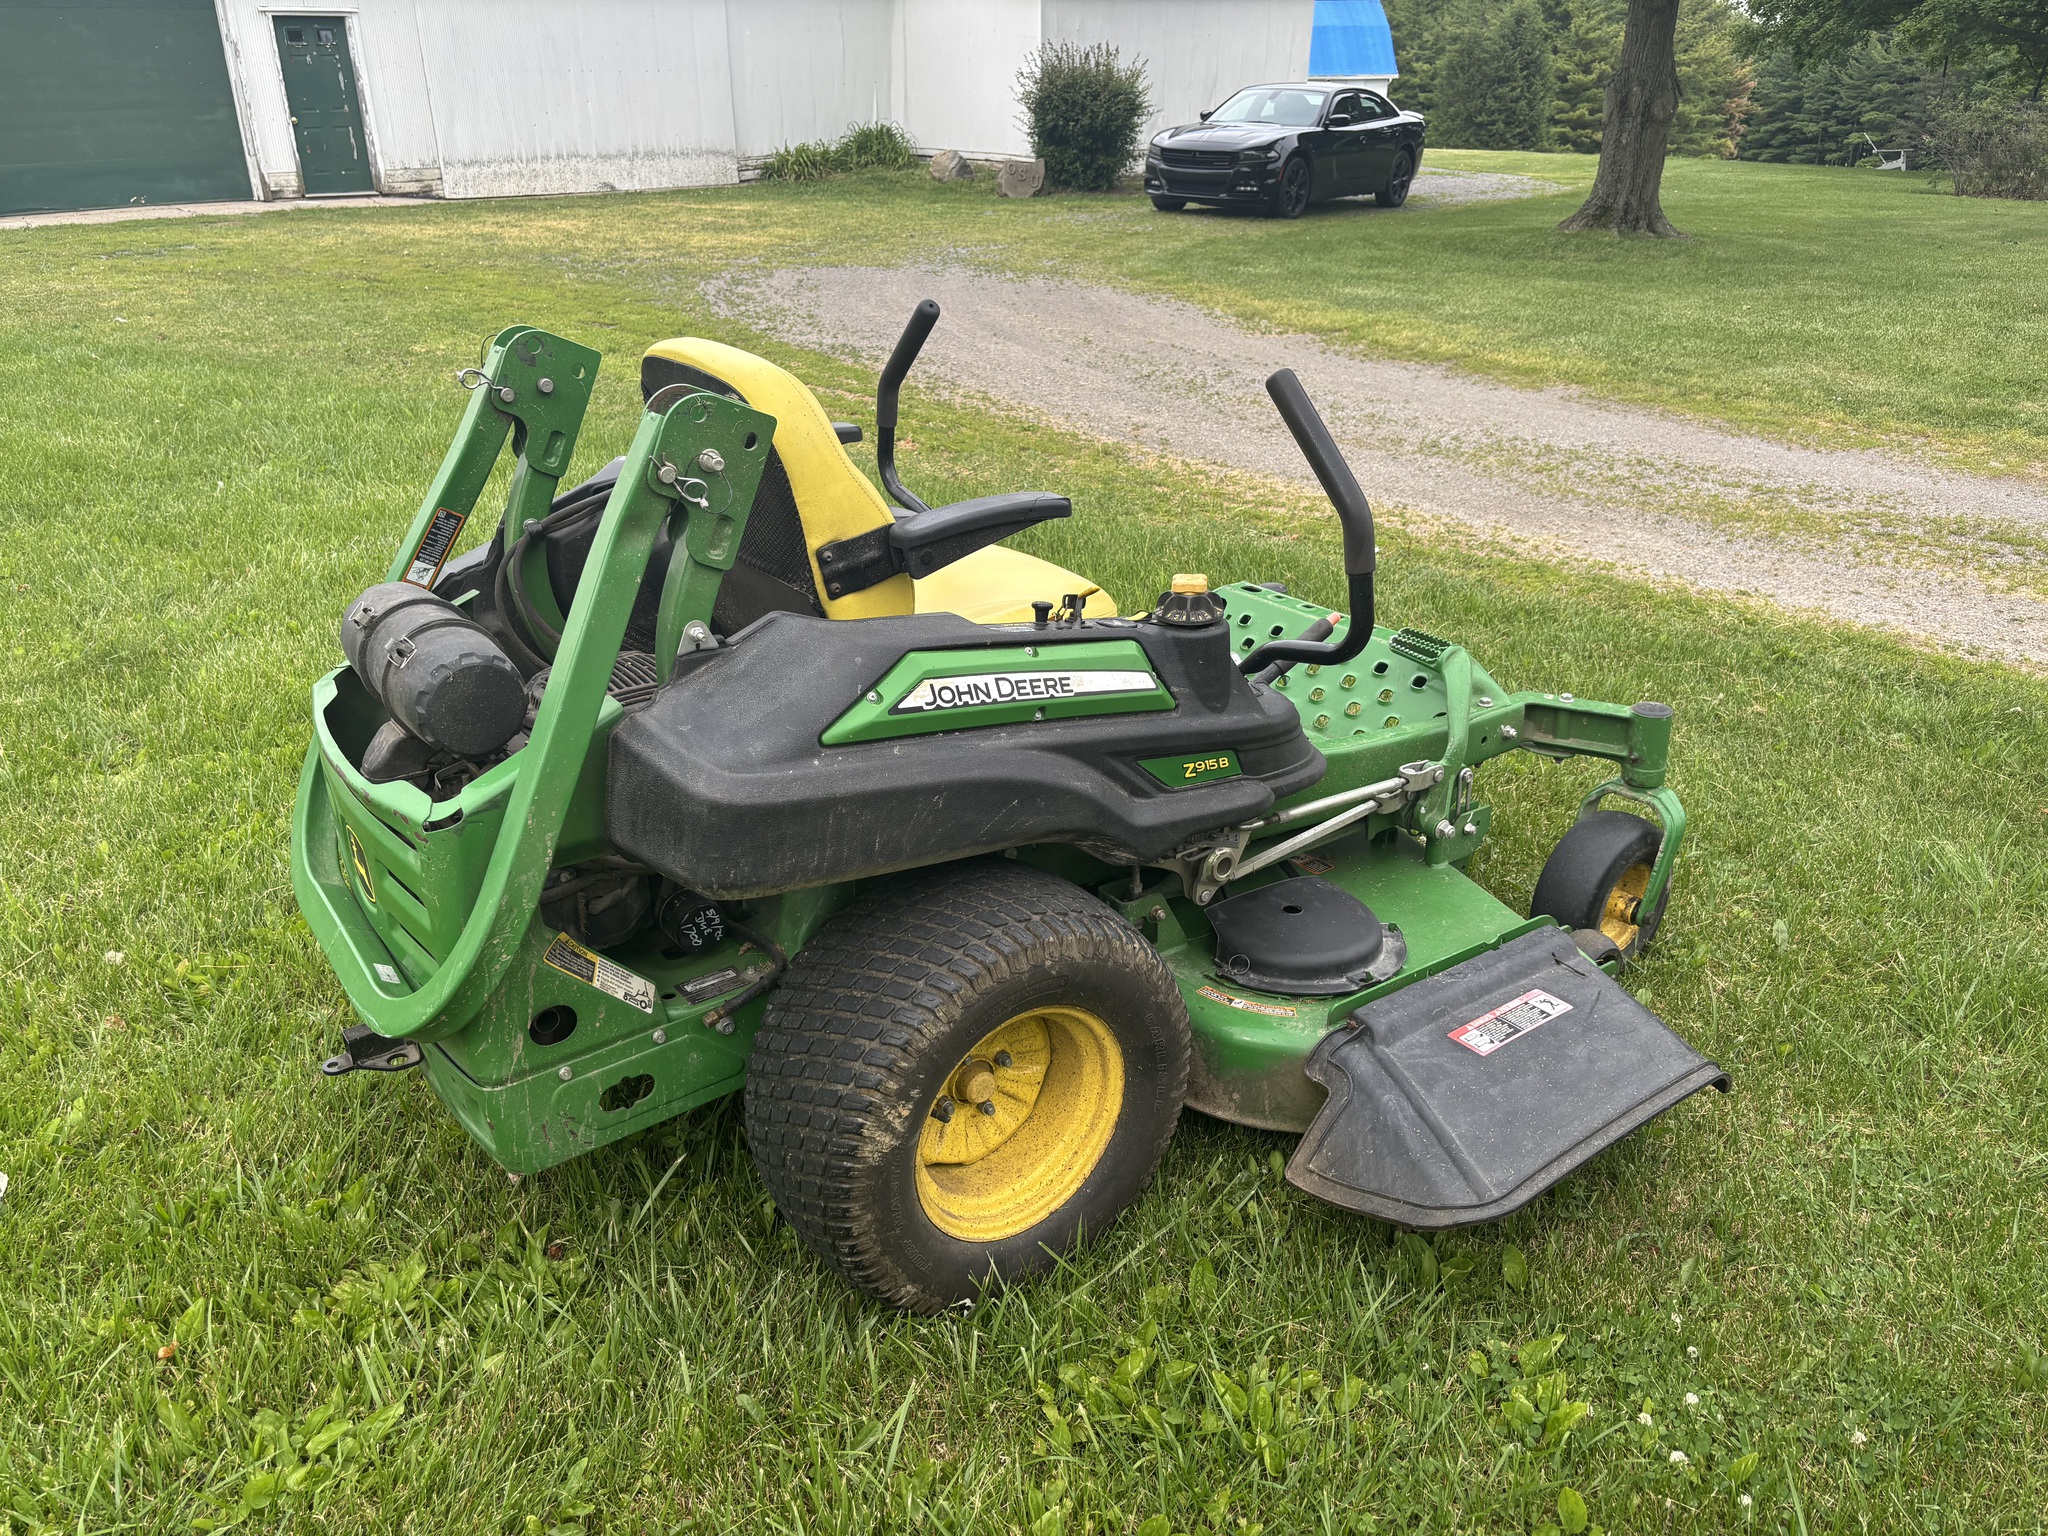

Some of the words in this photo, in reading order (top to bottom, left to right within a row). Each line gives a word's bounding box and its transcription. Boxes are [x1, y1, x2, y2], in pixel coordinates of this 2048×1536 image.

[925, 682, 992, 706] JOHN
[995, 677, 1073, 698] DEERE
[1183, 757, 1229, 778] Z915B
[681, 924, 702, 946] 1700
[568, 940, 588, 957] CAUTION
[1144, 1012, 1168, 1114] CARLISLE
[899, 1239, 934, 1275] TURF
